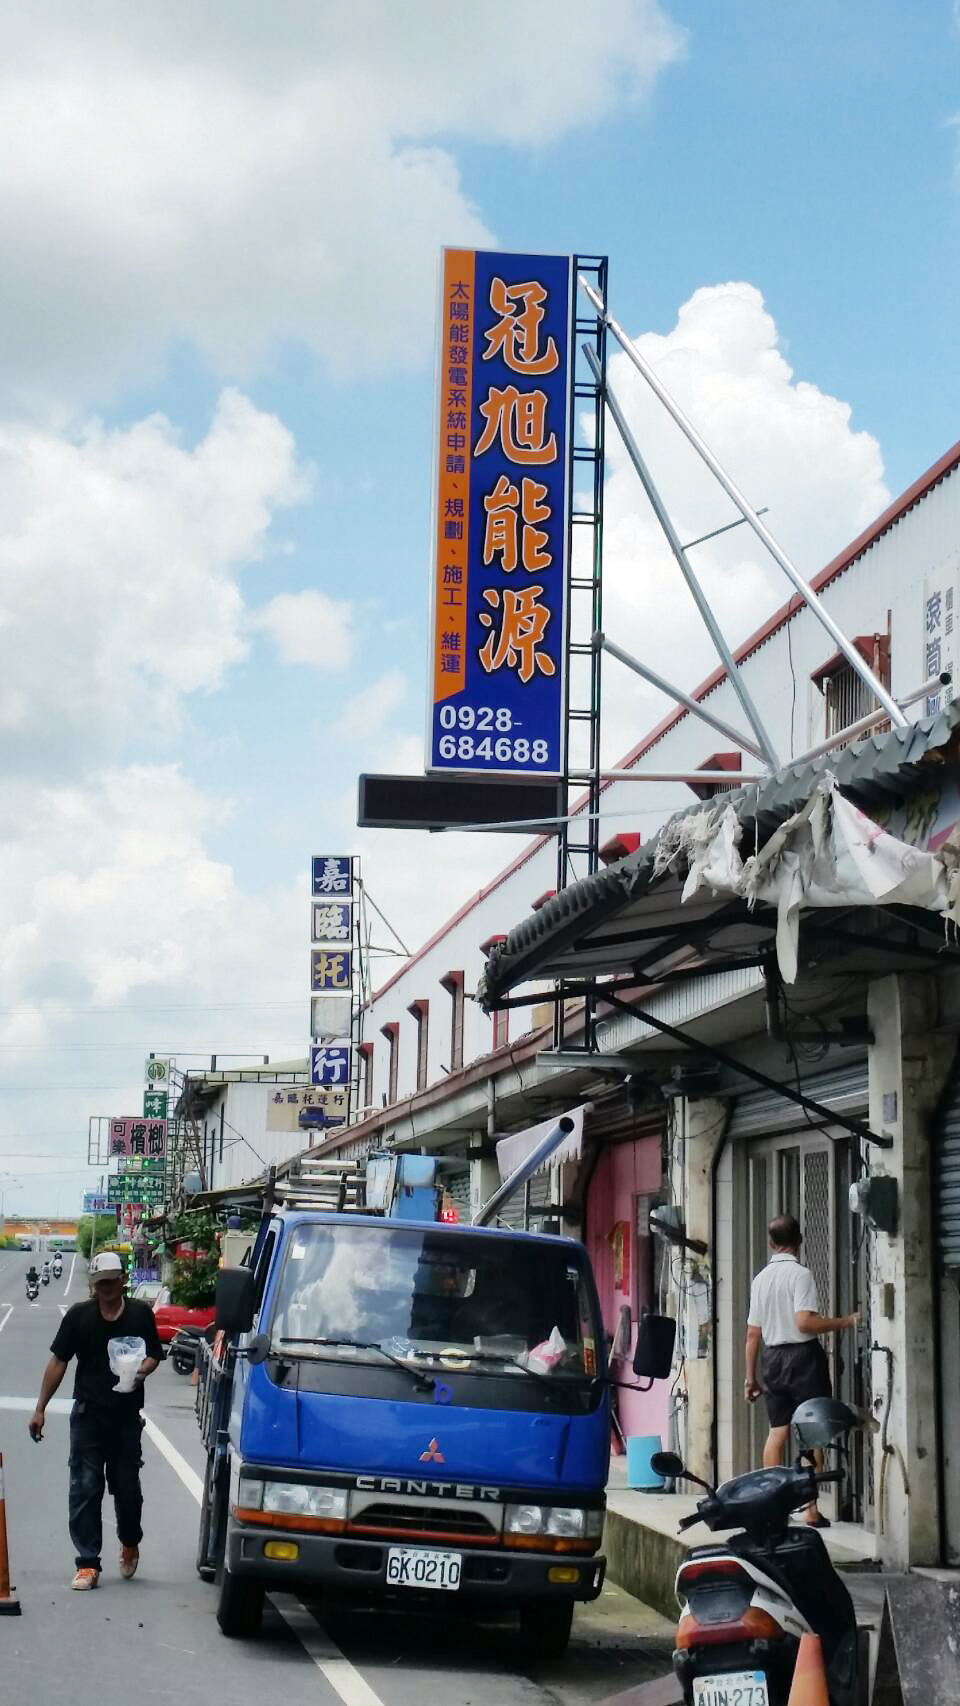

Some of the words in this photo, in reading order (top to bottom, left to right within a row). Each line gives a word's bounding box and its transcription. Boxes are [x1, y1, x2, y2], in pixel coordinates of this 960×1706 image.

[440, 280, 470, 674] 太陽能發電系統申請、規劃、施工、維運
[474, 277, 559, 683] 冠旭能源
[439, 705, 523, 732] 0928-
[439, 735, 549, 763] 684688
[112, 1121, 126, 1154] 可樂
[130, 1122, 164, 1155] 檳榔
[356, 1476, 500, 1499] CANTER
